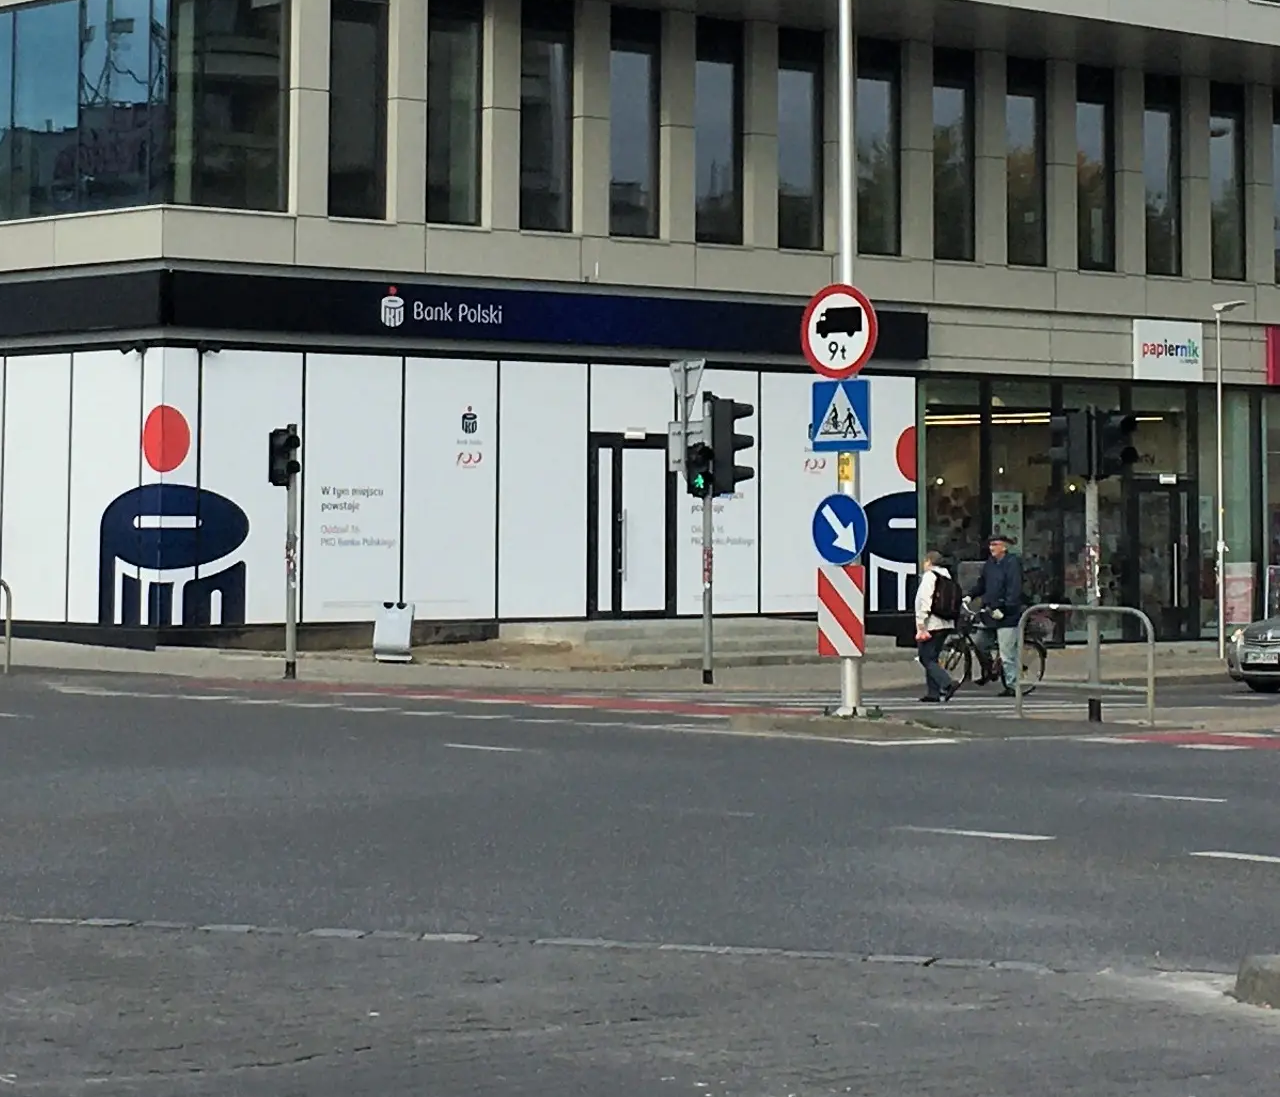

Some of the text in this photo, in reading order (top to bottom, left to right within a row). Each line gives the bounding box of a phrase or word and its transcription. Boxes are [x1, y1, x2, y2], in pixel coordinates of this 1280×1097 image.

[413, 301, 453, 321] Bank
[458, 303, 503, 324] Polski
[1142, 338, 1200, 358] papiernik
[321, 486, 331, 495] W
